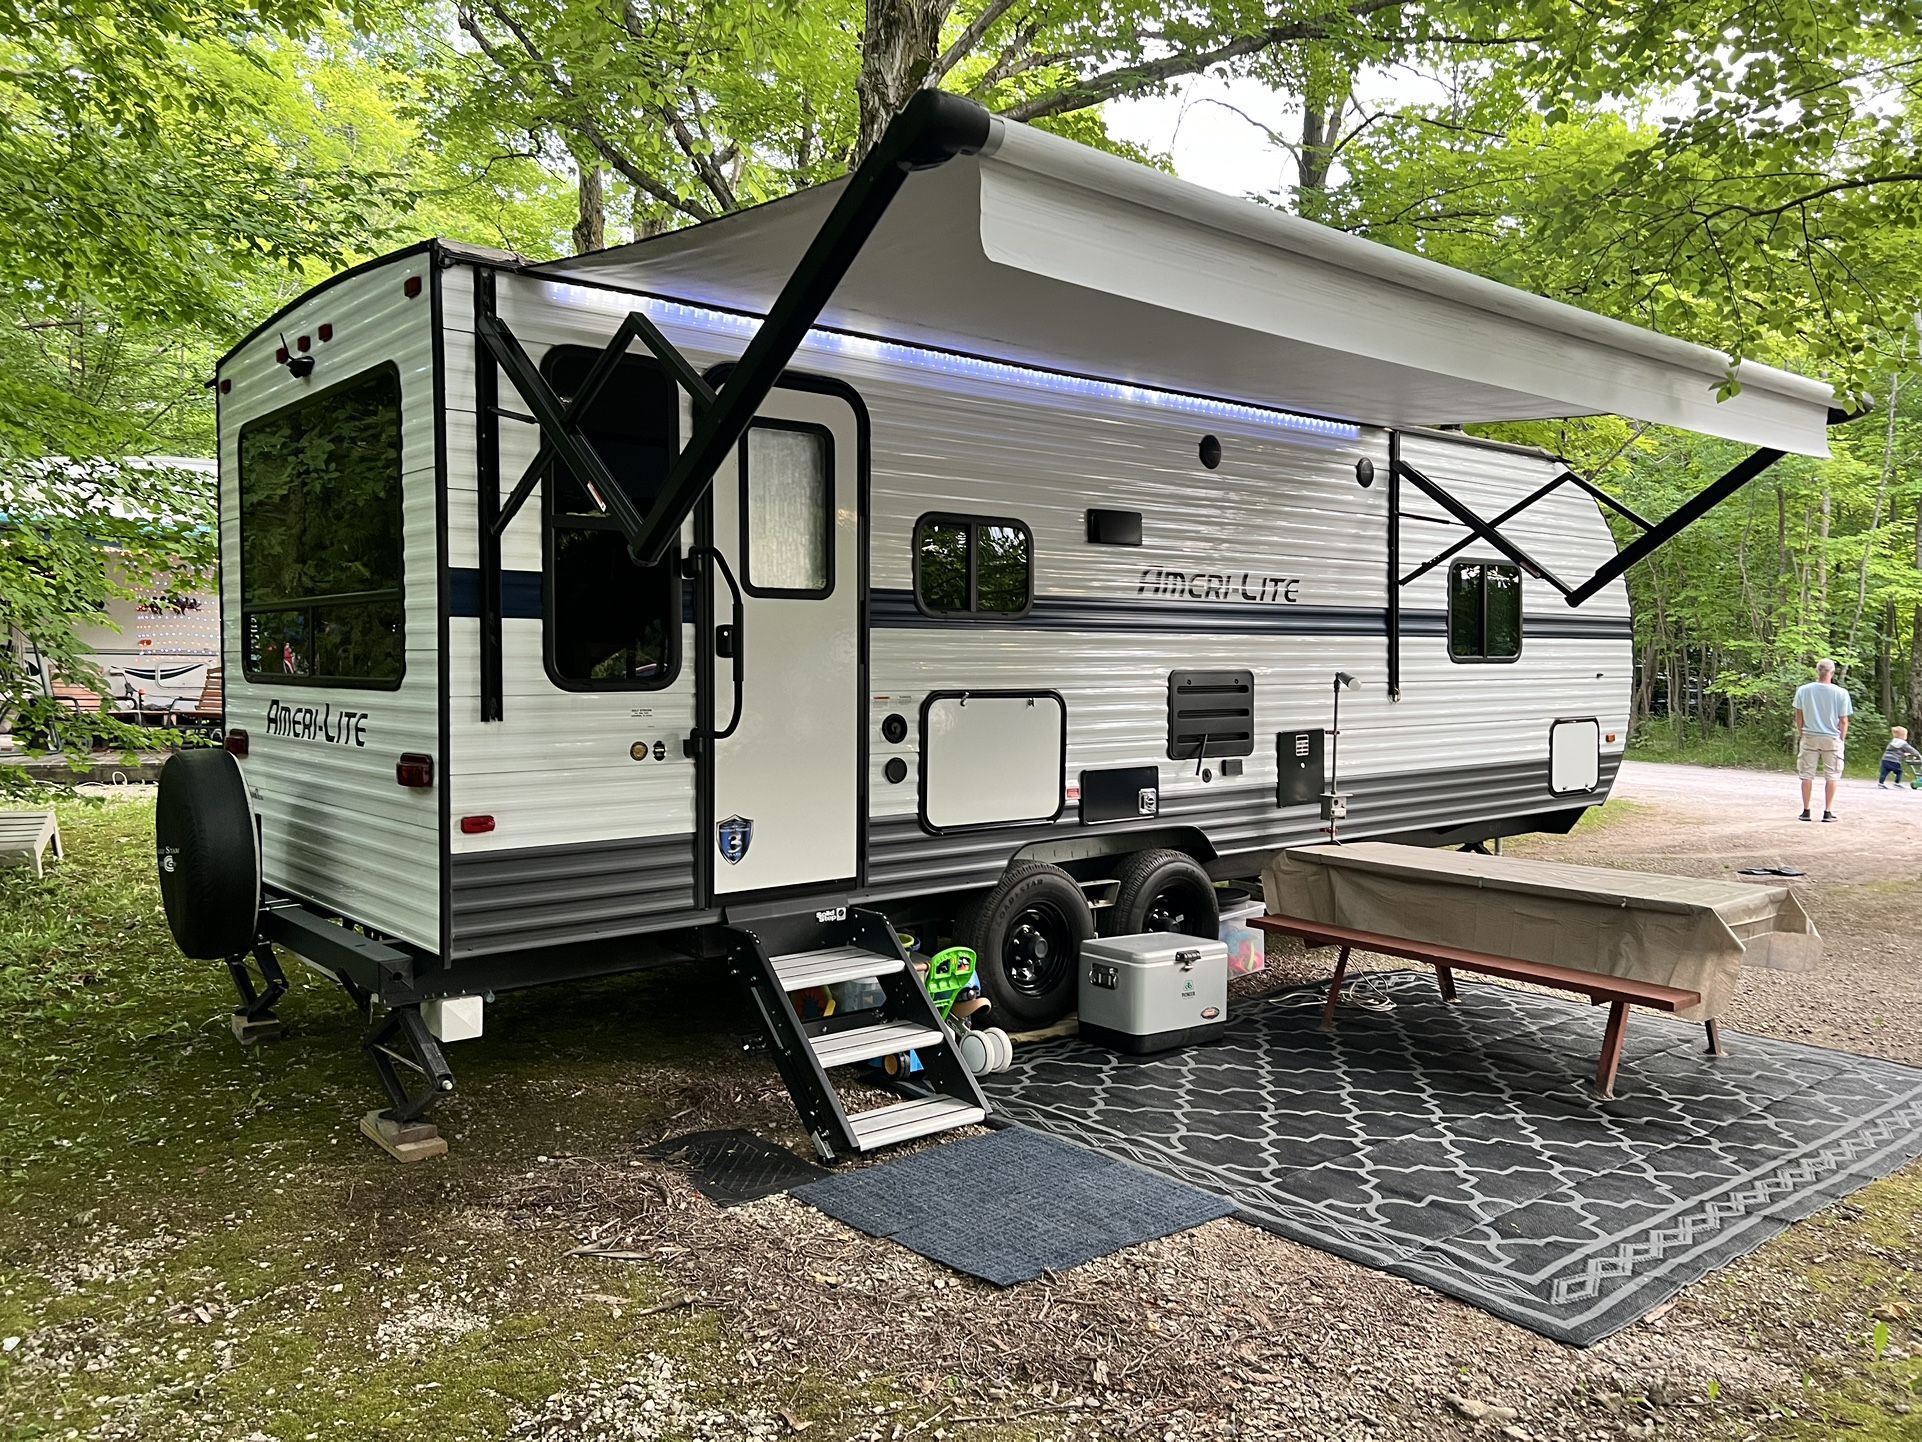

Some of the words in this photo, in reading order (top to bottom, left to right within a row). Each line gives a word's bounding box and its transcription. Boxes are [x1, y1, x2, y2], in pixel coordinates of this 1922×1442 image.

[1137, 565, 1300, 603] AMERI-LITE
[266, 699, 368, 747] AMERI-LITE
[727, 832, 743, 853] 3
